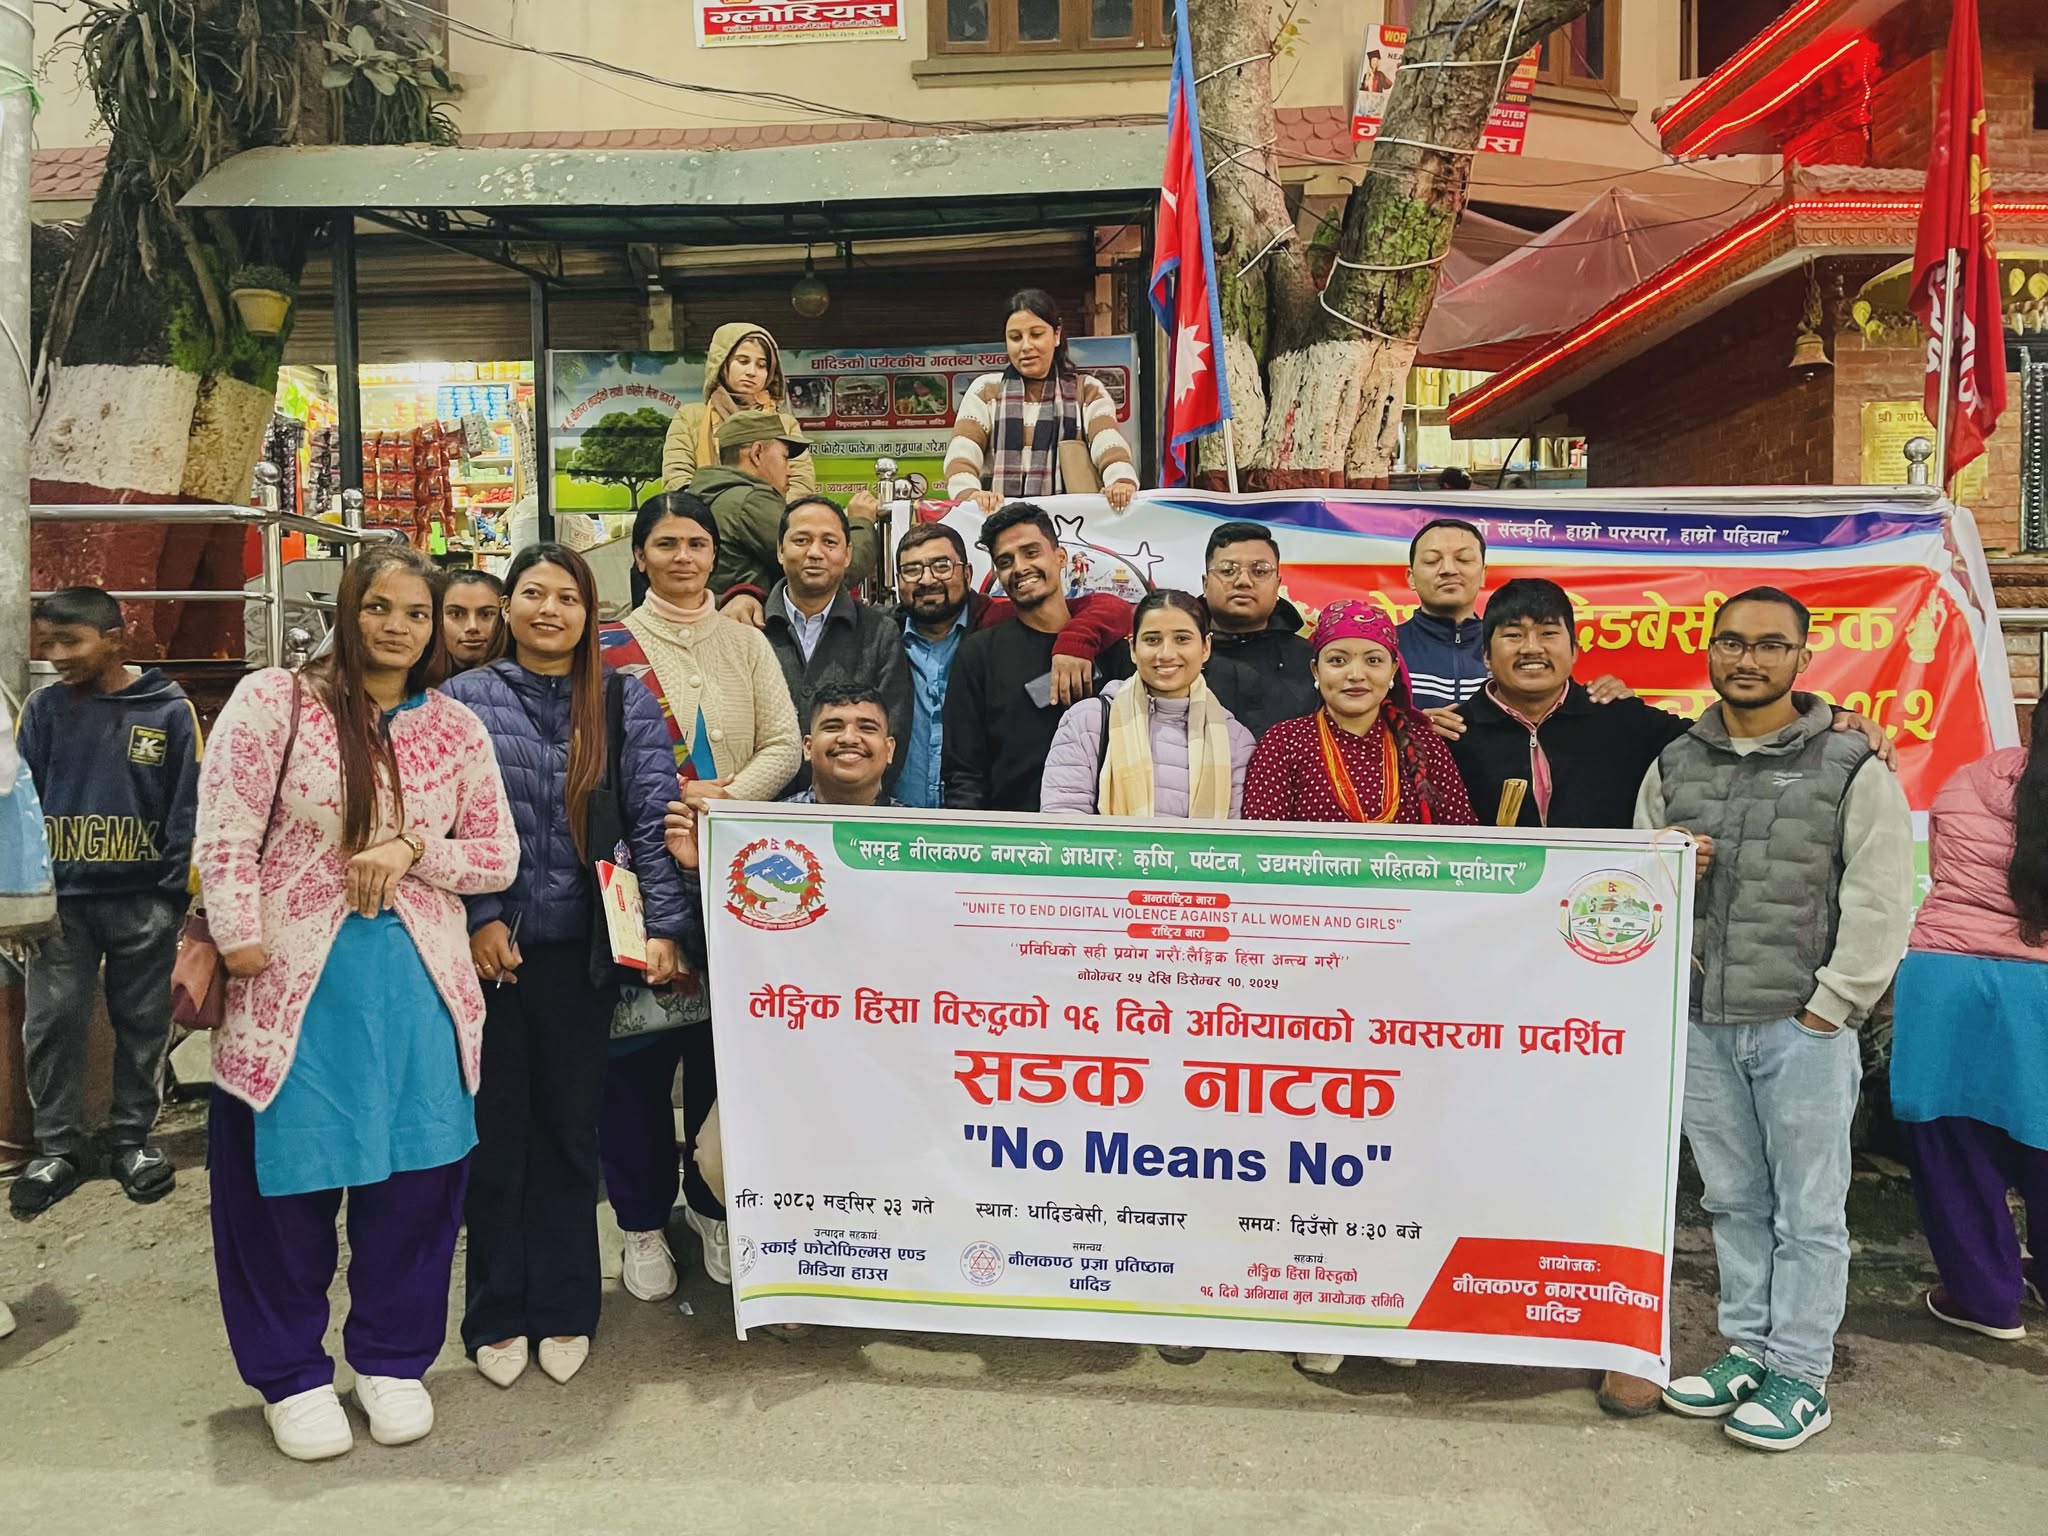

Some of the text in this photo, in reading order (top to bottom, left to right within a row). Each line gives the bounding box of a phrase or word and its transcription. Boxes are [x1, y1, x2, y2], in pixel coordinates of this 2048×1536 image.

[709, 3, 893, 24] ग्लोरियस
[1566, 522, 1601, 541] हाम्रो
[1680, 529, 1713, 546] हाम्रो
[909, 836, 983, 863] नीलकण्ठ
[991, 841, 1052, 868] नगरको
[1256, 849, 1361, 877] उद्यमशीलता
[1369, 852, 1440, 881] सहितको
[963, 902, 1402, 931] "UNITE TO END DIGITAL VIOLENCE AGAINST ALL WOMEN AND GIRLS"
[1083, 943, 1107, 961] सही
[1114, 943, 1149, 961] प्रयोग
[1128, 971, 1143, 984] २५
[1148, 970, 1171, 986] देखि
[1249, 978, 1280, 991] २०२५
[854, 986, 921, 1025] हिंसा
[1063, 1005, 1100, 1035] १६
[1116, 997, 1174, 1035] दिने
[1186, 1002, 1355, 1043] अभियानको
[1368, 1018, 1505, 1050] अवसरमा
[1518, 1017, 1626, 1057] प्रदर्शित
[953, 1049, 1401, 1120] सडक नाटक
[963, 1124, 1392, 1187] "No Means No"
[773, 1192, 815, 1212] २०८२
[883, 1198, 902, 1216] २३
[912, 1196, 935, 1215] गते
[1116, 1205, 1188, 1230] बीचबजार
[1290, 1213, 1338, 1237] दिउँसो
[1396, 1221, 1422, 1240] बजे
[760, 1238, 927, 1262] स्काई फोटोफिल्मस एण्ड
[1008, 1250, 1074, 1269] नीलकण्ठ
[1080, 1256, 1108, 1271] प्रज्ञा
[1115, 1256, 1174, 1274] प्रतिष्ठान
[798, 1260, 888, 1281] मिडिया हाउस
[1069, 1275, 1112, 1292] धादिङ
[1200, 1283, 1405, 1308] १६ दिने अभियान मुल आयोजक समिति
[1452, 1273, 1660, 1313] नीलकण्ठ नगरपालिका
